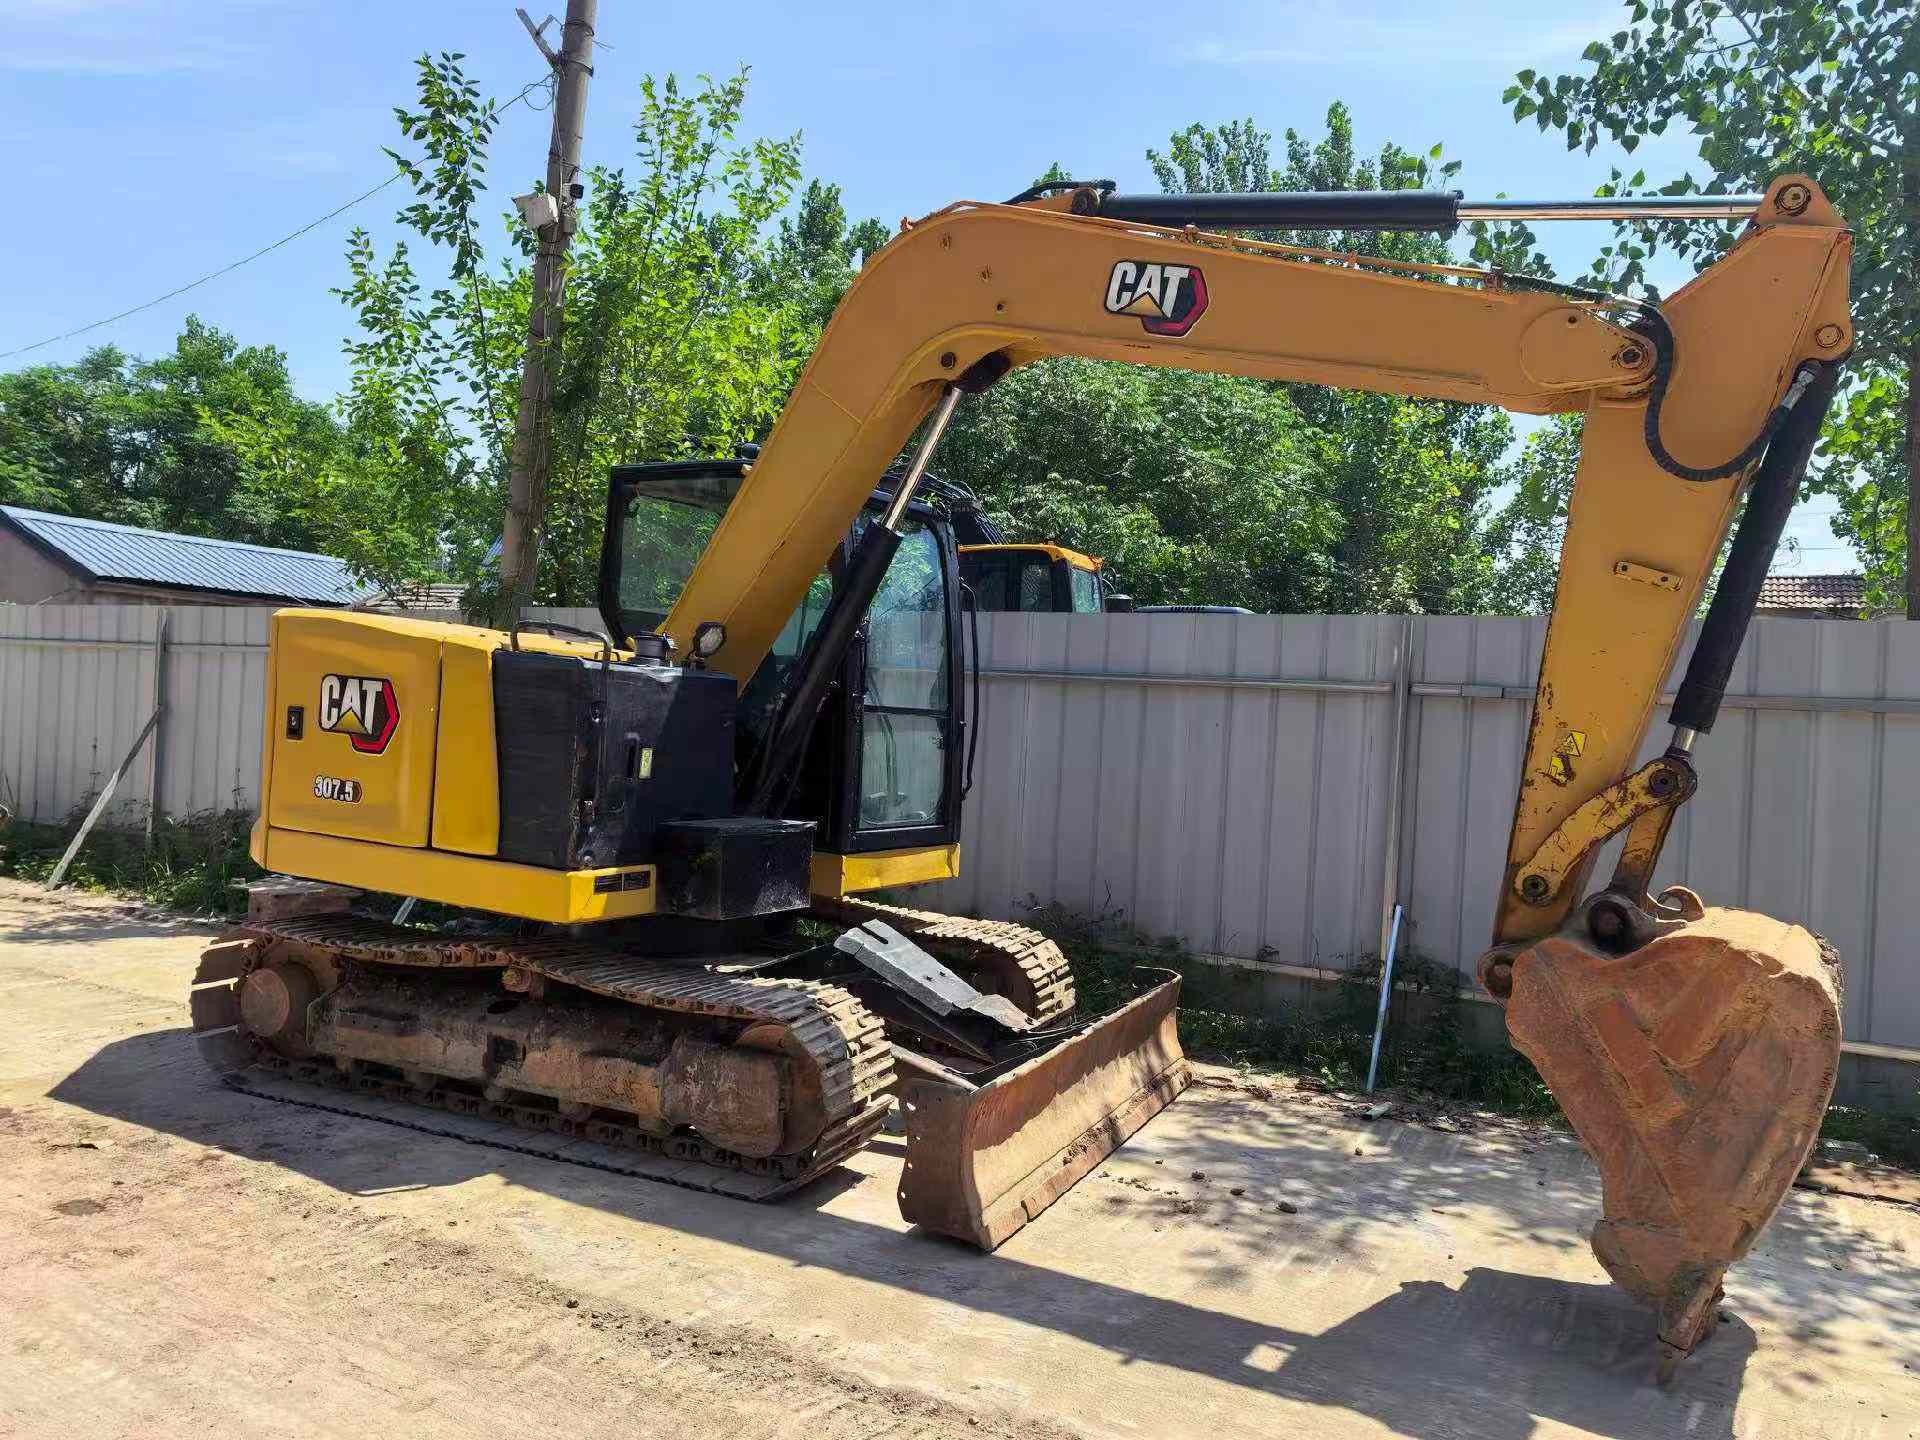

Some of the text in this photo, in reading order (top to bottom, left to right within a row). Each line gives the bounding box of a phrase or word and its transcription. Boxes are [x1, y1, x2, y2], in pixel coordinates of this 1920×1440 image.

[1107, 262, 1190, 318] CAT
[320, 675, 383, 735] CAT
[314, 775, 354, 801] 307.5
